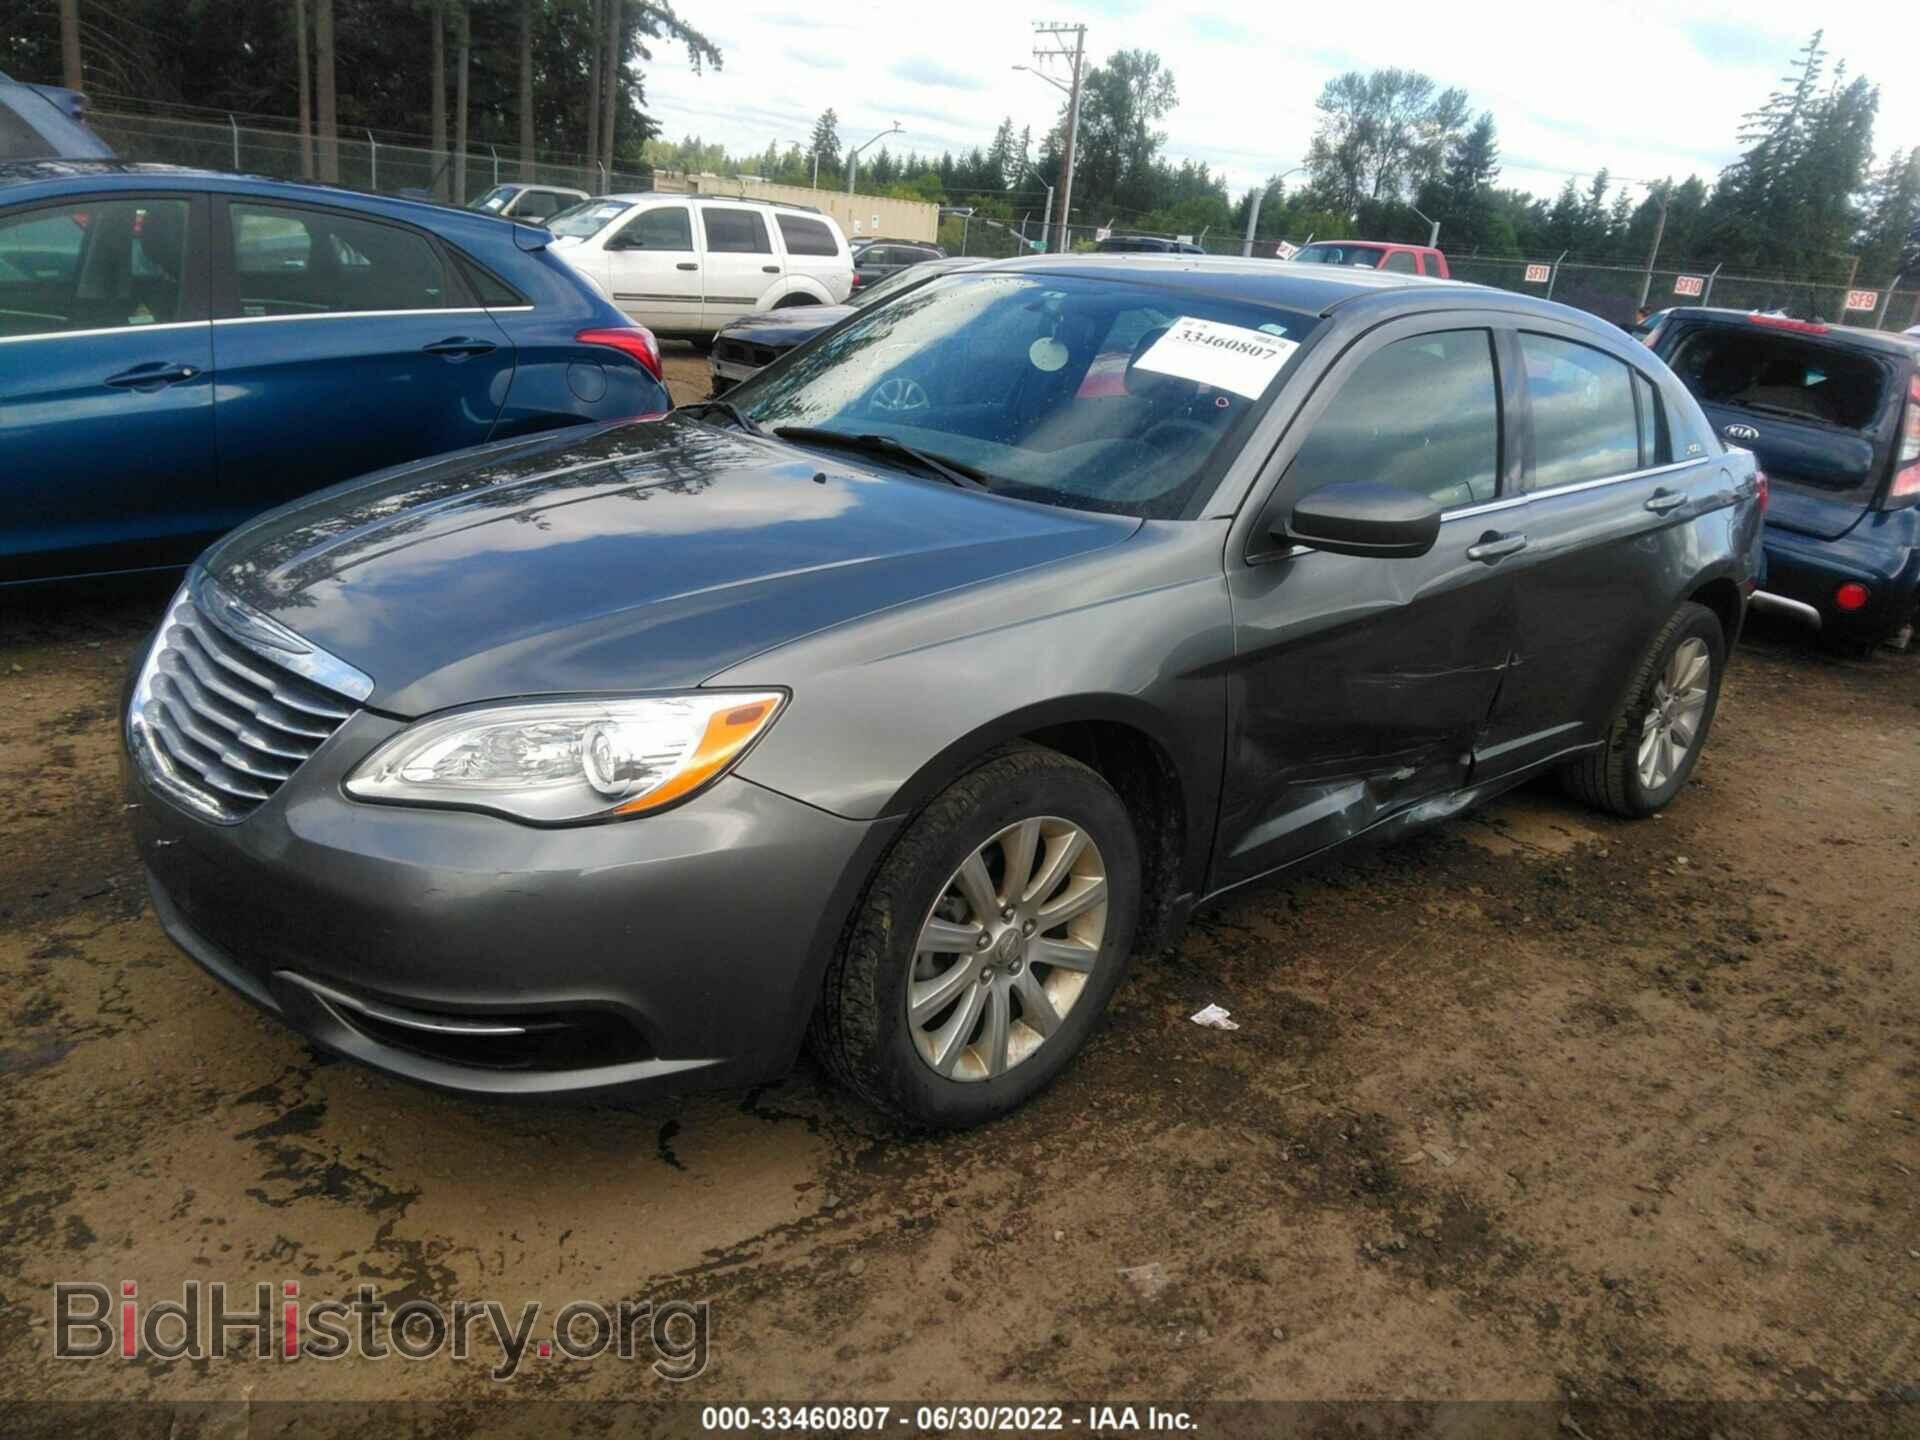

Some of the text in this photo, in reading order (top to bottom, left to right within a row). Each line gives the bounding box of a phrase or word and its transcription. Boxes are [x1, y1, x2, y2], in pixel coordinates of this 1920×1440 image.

[1678, 278, 1701, 294] SF10
[1848, 292, 1876, 308] SF9
[1175, 329, 1277, 360] 33460807
[1726, 425, 1756, 440] KIA
